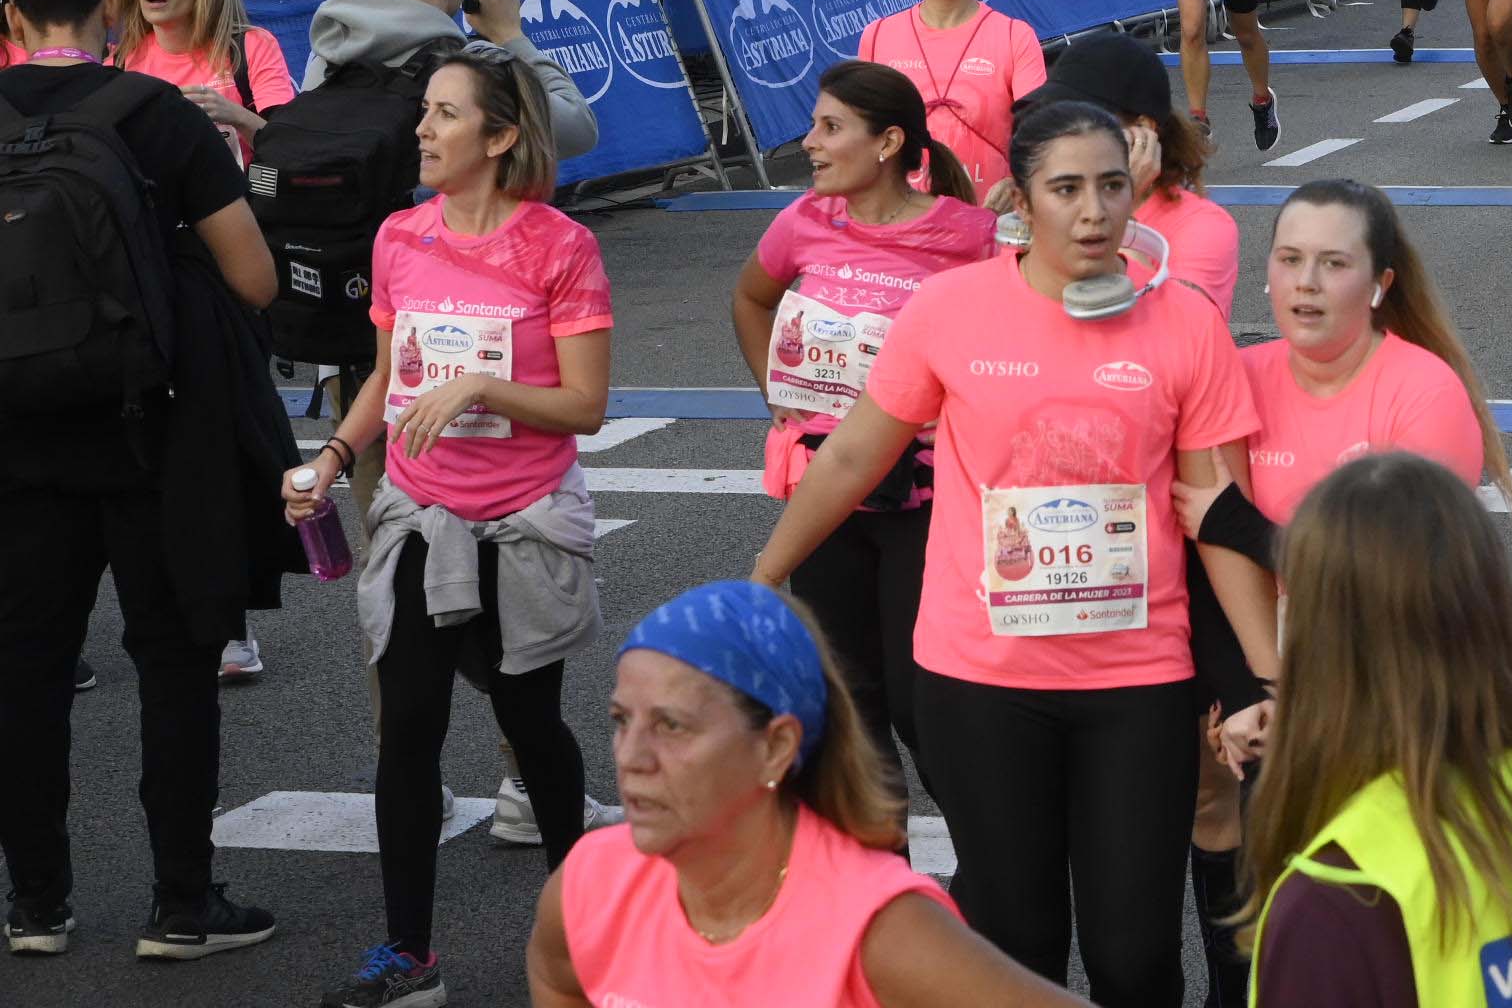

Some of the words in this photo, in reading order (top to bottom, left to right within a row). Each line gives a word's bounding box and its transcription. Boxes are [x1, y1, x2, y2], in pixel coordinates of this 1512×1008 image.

[625, 13, 658, 27] CENTRAL
[531, 28, 560, 43] CENTRAL
[561, 25, 591, 38] LECHERA
[617, 21, 675, 64] ASTUR
[854, 268, 921, 291] Santande
[402, 295, 436, 312] Sports
[456, 300, 527, 318] Santander
[426, 334, 470, 349] ASTURIANA
[807, 346, 848, 369] 016
[814, 368, 841, 380] 3231
[970, 359, 1040, 378] OYSHO
[813, 382, 824, 391] DE
[824, 384, 835, 392] LA
[778, 389, 816, 403] OYSHO
[1249, 449, 1295, 467] YSHO
[1104, 503, 1134, 512] SUMA
[1032, 512, 1094, 526] ASTURIANA
[1038, 544, 1094, 567] 016
[1045, 572, 1088, 586] 19126
[1005, 591, 1047, 603] CARRERA
[1050, 591, 1063, 601] DE
[1064, 590, 1077, 600] LA
[1079, 589, 1110, 599] MUJER
[1003, 612, 1050, 626] OYSHO
